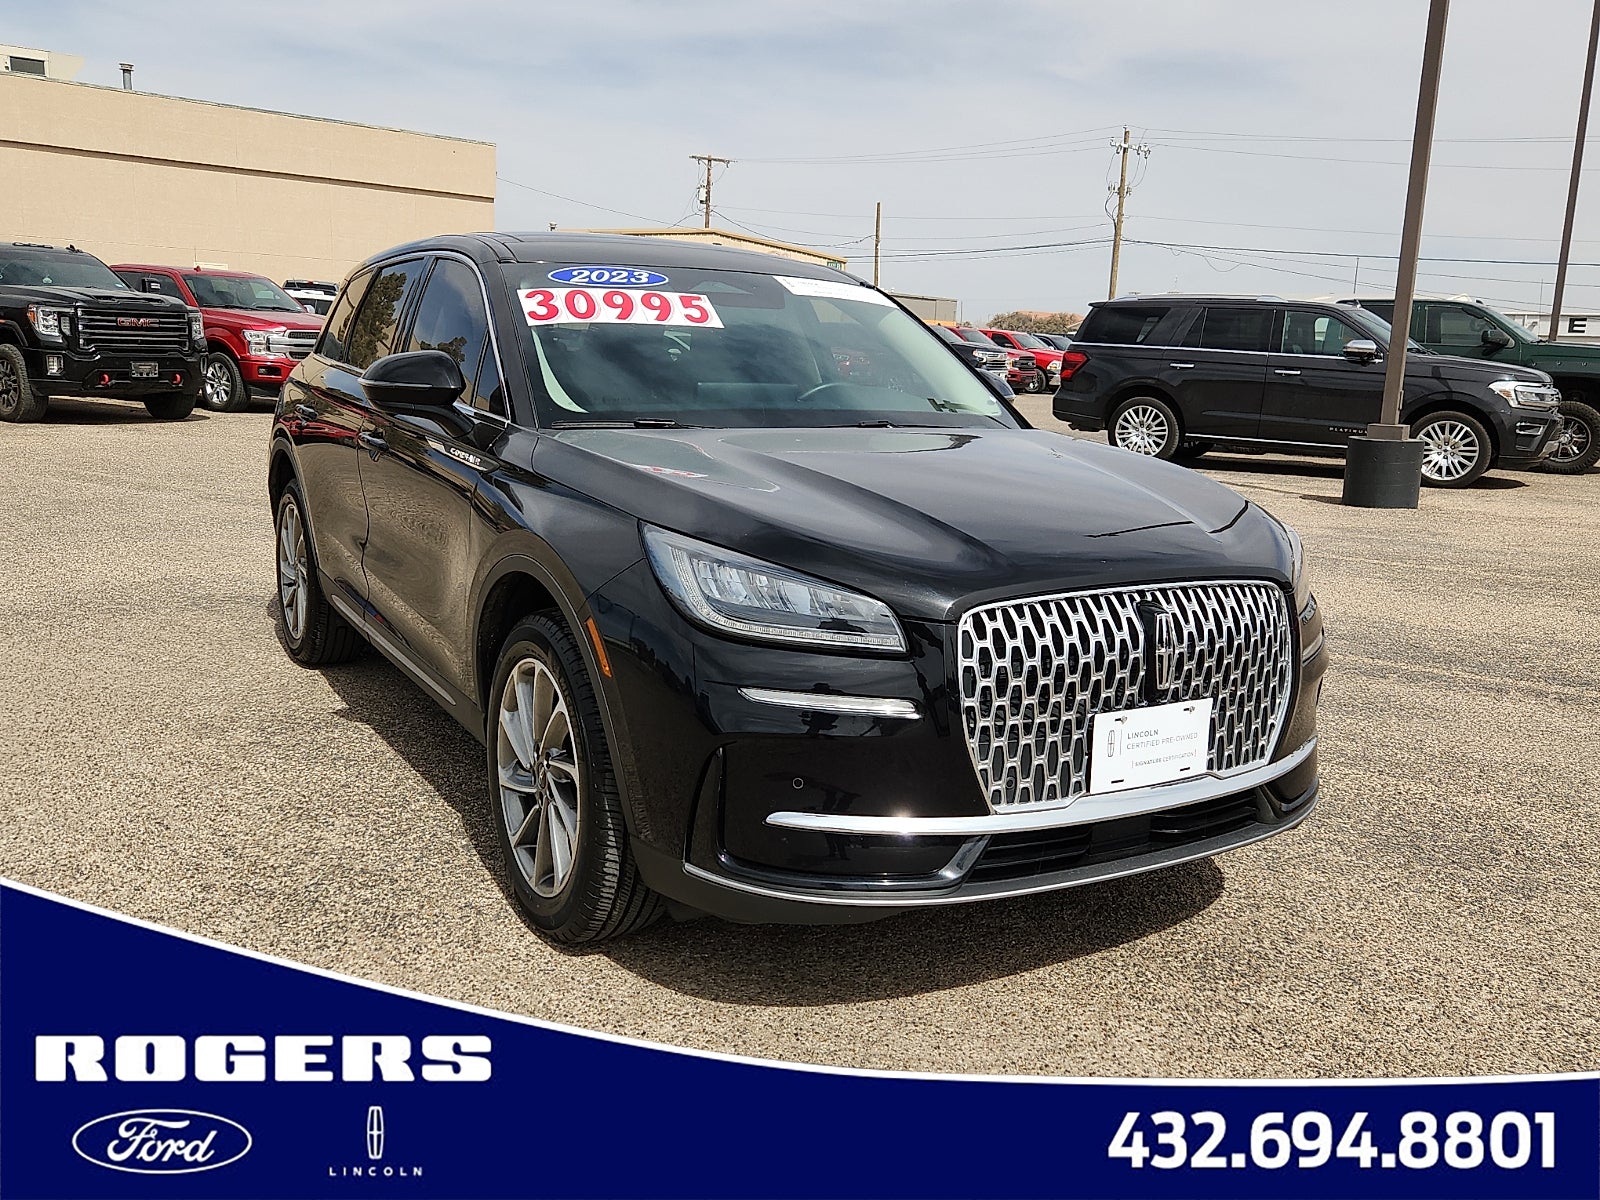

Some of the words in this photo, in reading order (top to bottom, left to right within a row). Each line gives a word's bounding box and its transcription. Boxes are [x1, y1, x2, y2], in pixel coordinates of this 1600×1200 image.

[569, 270, 650, 283] 2023
[525, 290, 712, 323] 30995
[117, 317, 160, 327] GMC
[1126, 739, 1160, 750] CERTIFIED
[1161, 732, 1198, 745] PRE-OWNED
[1127, 729, 1159, 740] LINCOLN
